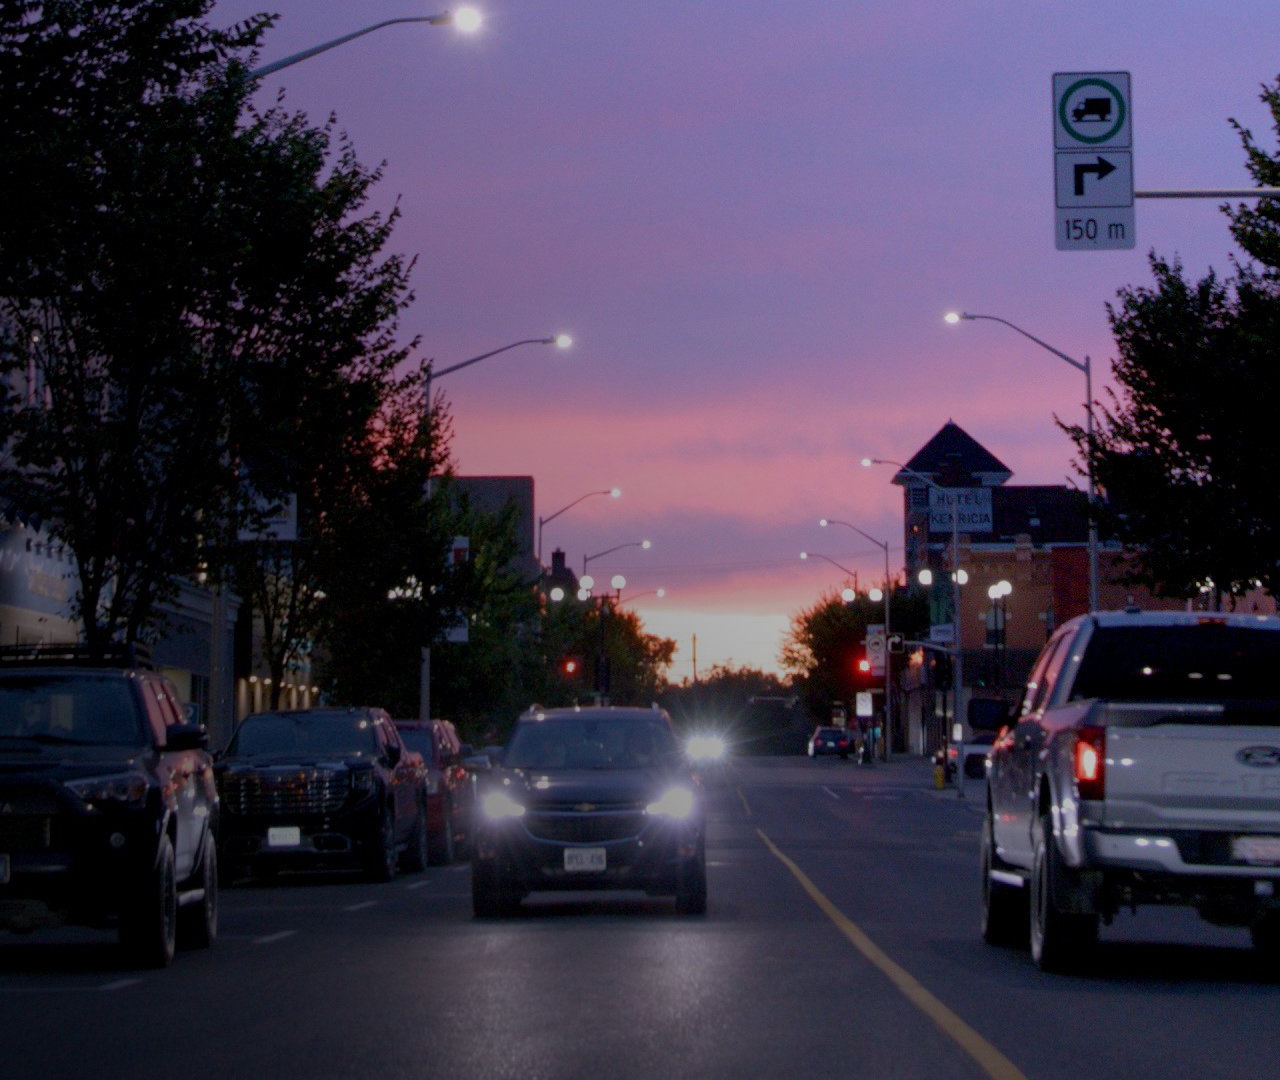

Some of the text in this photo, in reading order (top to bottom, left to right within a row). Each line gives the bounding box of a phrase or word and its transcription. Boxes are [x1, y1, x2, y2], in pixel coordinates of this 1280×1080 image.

[1065, 218, 1125, 240] 150 m
[936, 493, 983, 506] HOTEL
